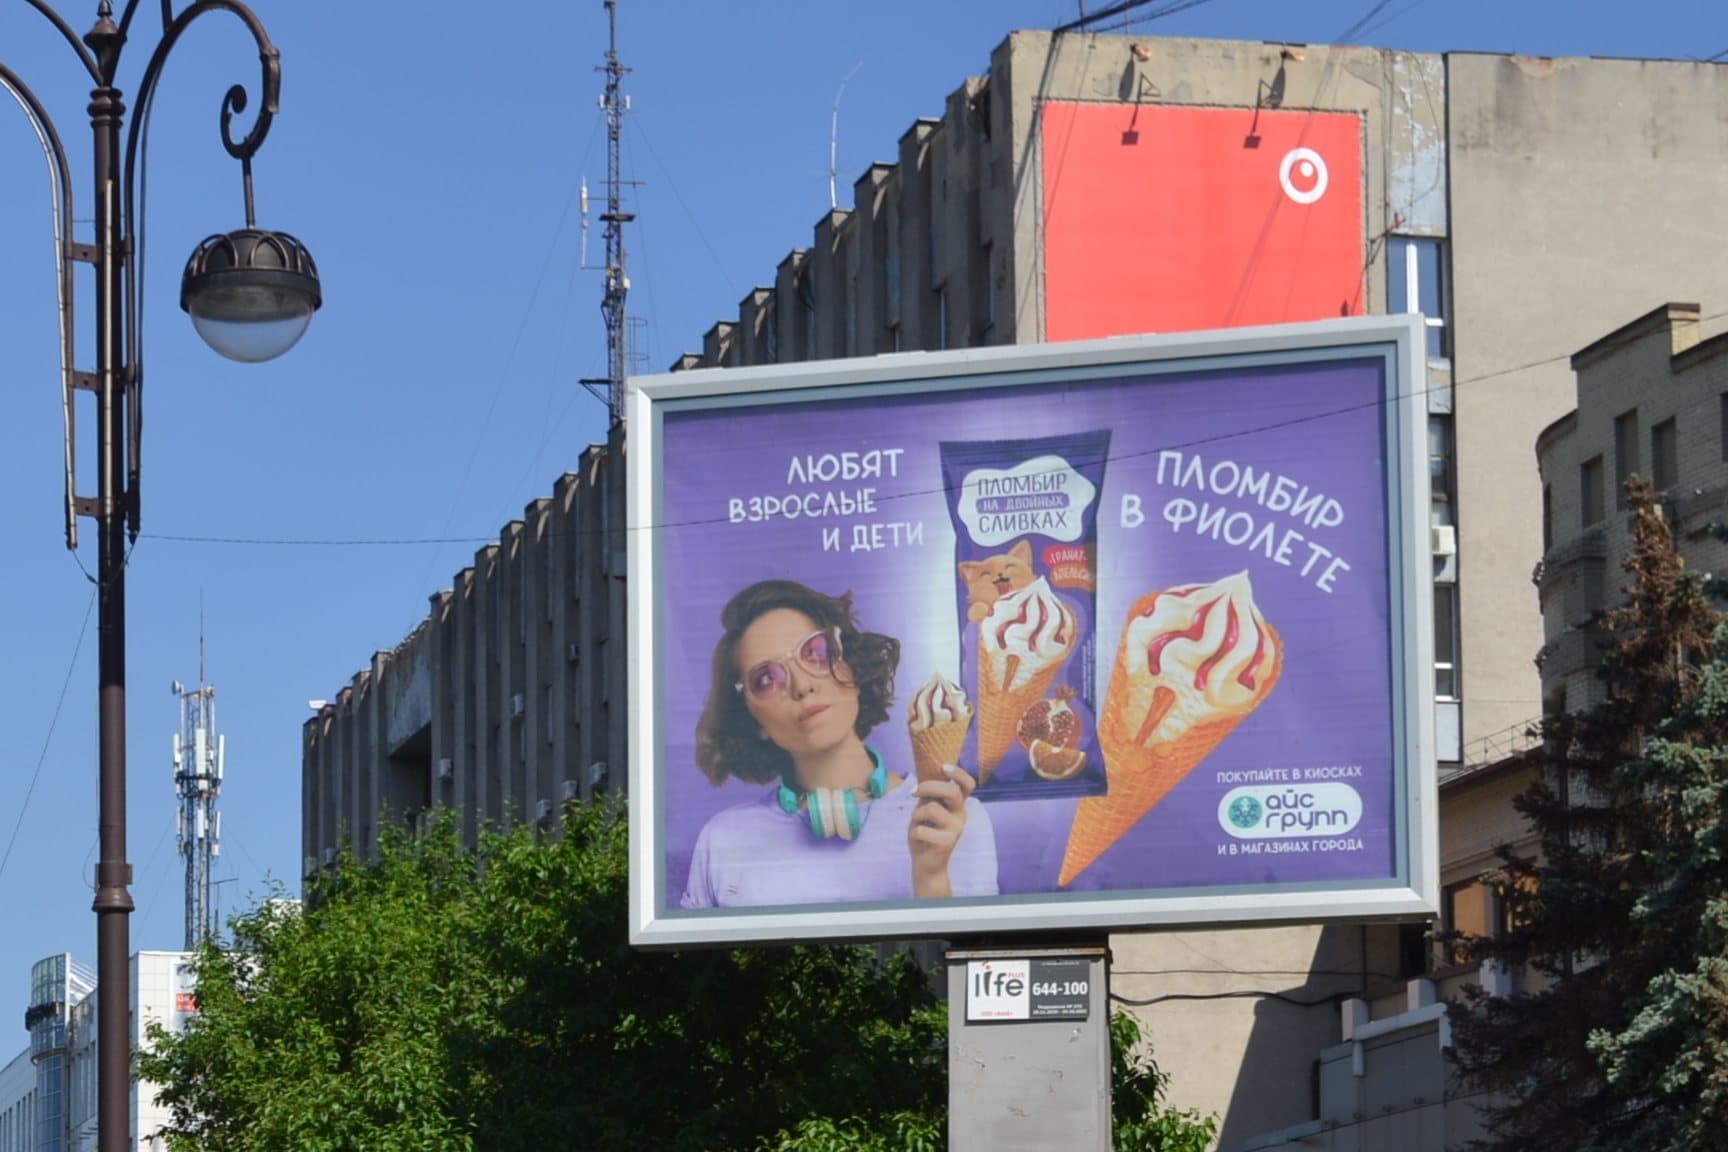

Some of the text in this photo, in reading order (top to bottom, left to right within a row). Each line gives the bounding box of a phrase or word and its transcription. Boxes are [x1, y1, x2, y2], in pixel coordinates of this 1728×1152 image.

[787, 449, 904, 484] ЛЮБЯТ
[977, 473, 1067, 497] ПЛОМБИР
[1156, 450, 1344, 529] ПЛОМБИР
[729, 488, 878, 523] ВЗРОСЛЫЕ
[983, 494, 1064, 511] НА ДВОЙНЫХ
[978, 511, 1068, 534] СЛИВКАХ
[823, 521, 923, 552] И ДЕТИ
[1120, 494, 1351, 594] В ФИОЛЕТЕ
[1217, 766, 1362, 783] ПОКУПАЙТЕ В КИОСКАХ
[1265, 789, 1315, 810] айс
[1265, 809, 1348, 832] групп
[1217, 839, 1363, 855] И В МАГАЗИНАХ ГОРОДА
[1032, 981, 1088, 996] 644-100
